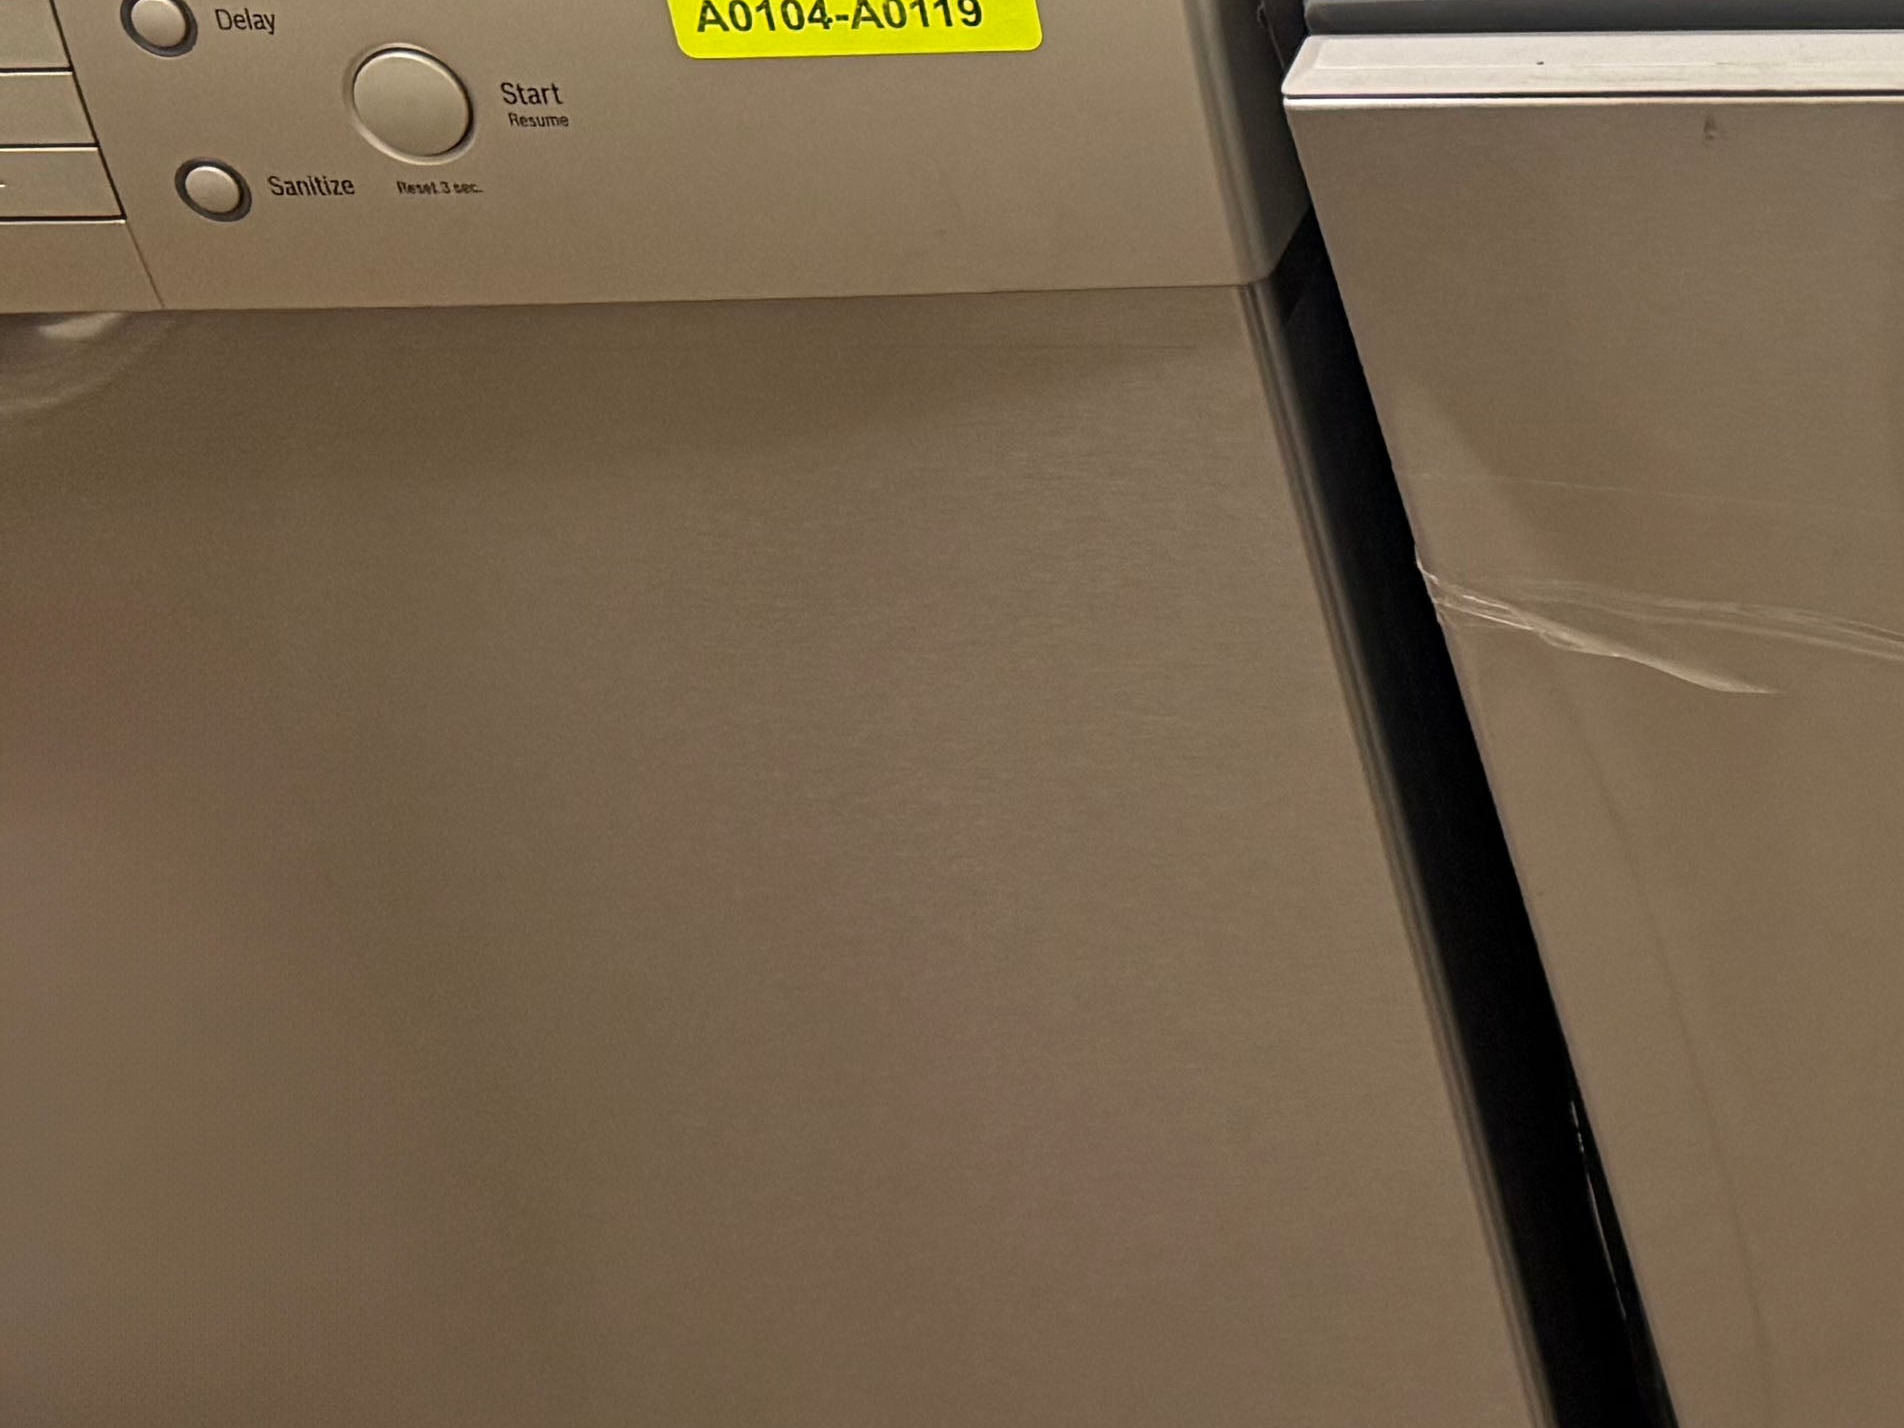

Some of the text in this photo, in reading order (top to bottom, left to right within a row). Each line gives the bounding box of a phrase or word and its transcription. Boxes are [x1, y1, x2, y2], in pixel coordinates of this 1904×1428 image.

[215, 8, 276, 35] Delay
[500, 82, 563, 106] Start
[509, 113, 569, 128] Resume
[268, 176, 355, 196] Sanitize
